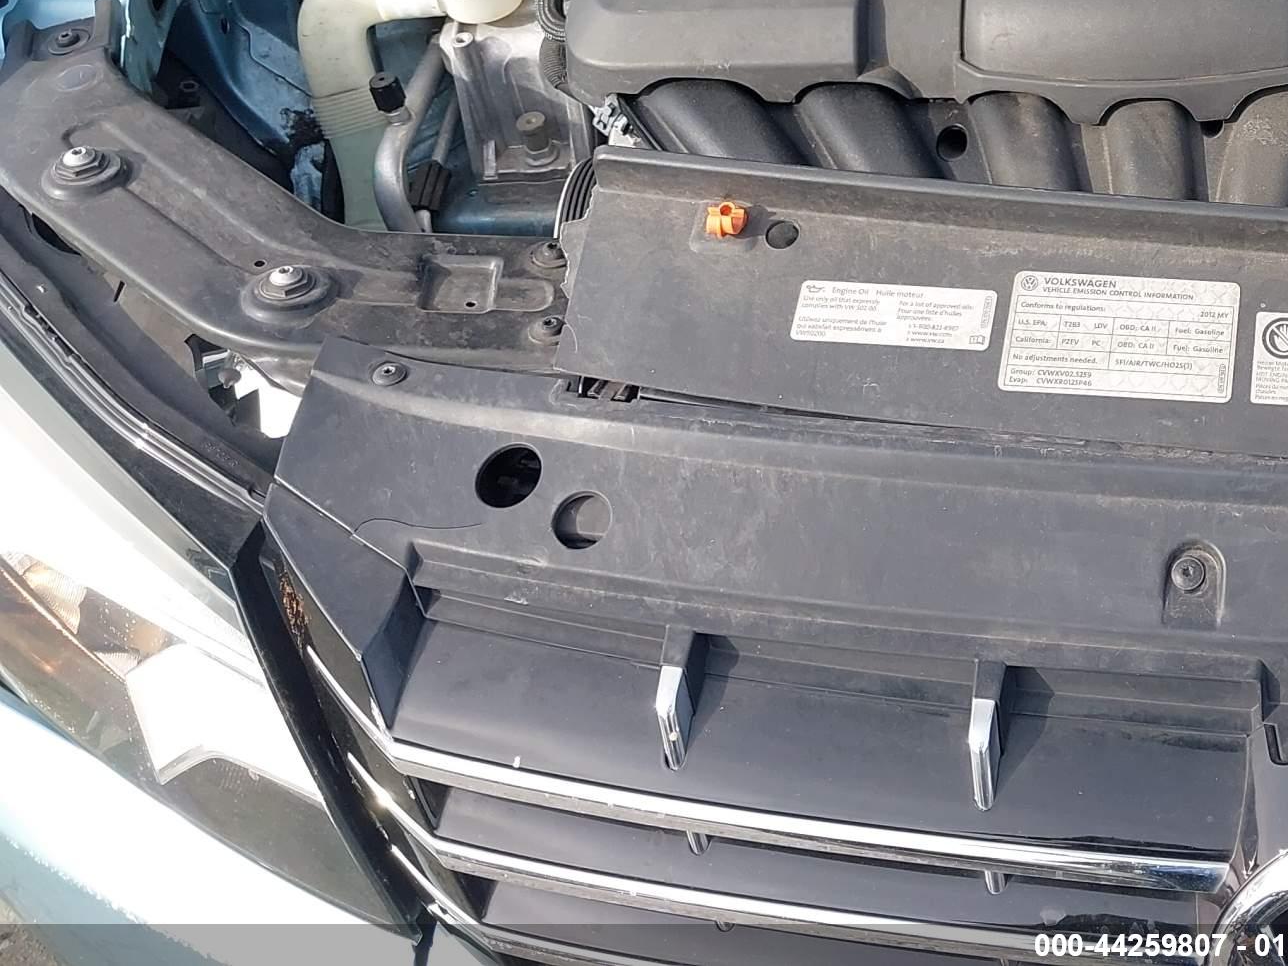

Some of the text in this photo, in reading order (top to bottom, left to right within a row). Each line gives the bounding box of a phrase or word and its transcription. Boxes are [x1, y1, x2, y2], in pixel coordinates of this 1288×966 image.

[1044, 277, 1117, 288] VOLKSWAGEN
[832, 287, 857, 295] Engine
[1144, 292, 1194, 300] INFORMATION
